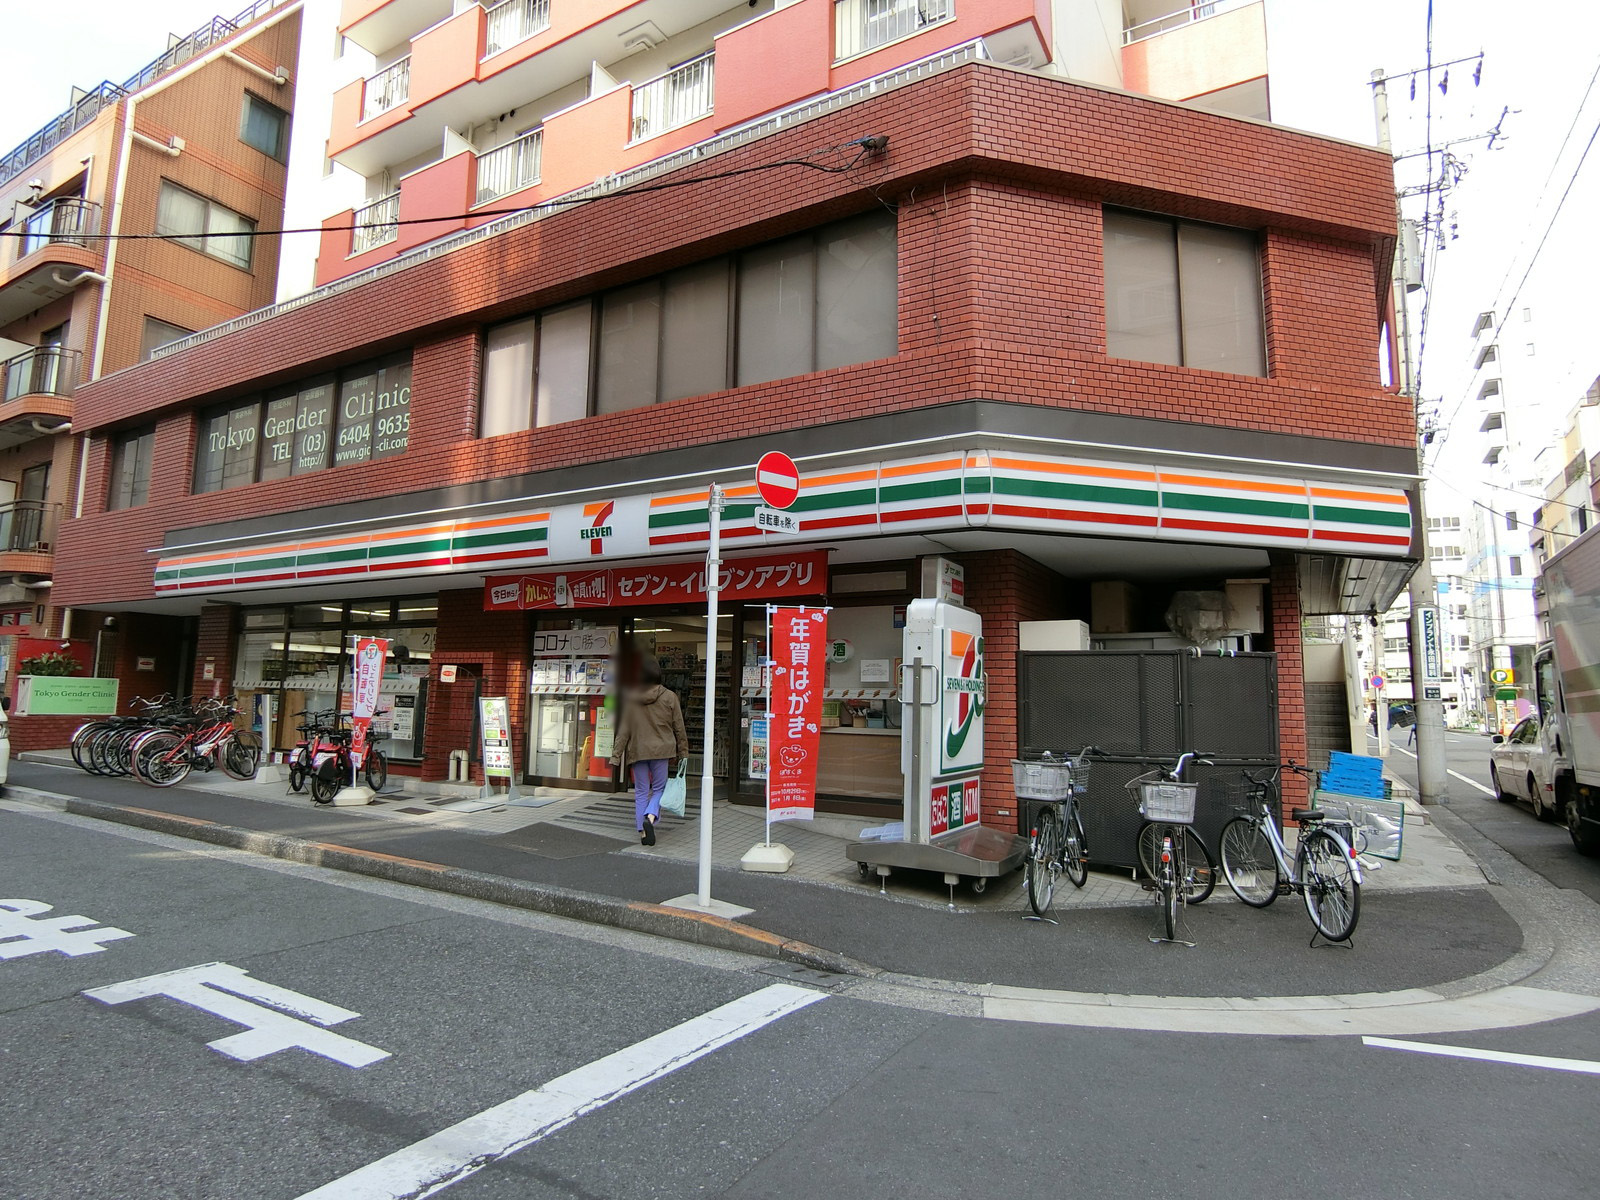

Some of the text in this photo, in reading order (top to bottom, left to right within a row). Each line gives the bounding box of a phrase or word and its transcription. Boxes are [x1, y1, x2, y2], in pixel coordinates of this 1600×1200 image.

[209, 386, 410, 453] Tokyo Gender Clinic
[272, 412, 410, 462] TEL (03) 6404 9635
[759, 512, 796, 530] 自転車を除く
[833, 642, 846, 656] 酒
[788, 617, 812, 738] 年賀はがき
[1496, 672, 1505, 681] P
[34, 690, 114, 698] Tokyo Gender Clinic
[932, 794, 948, 827] たばこ
[950, 791, 962, 822] 酒
[964, 788, 978, 817] ATM
